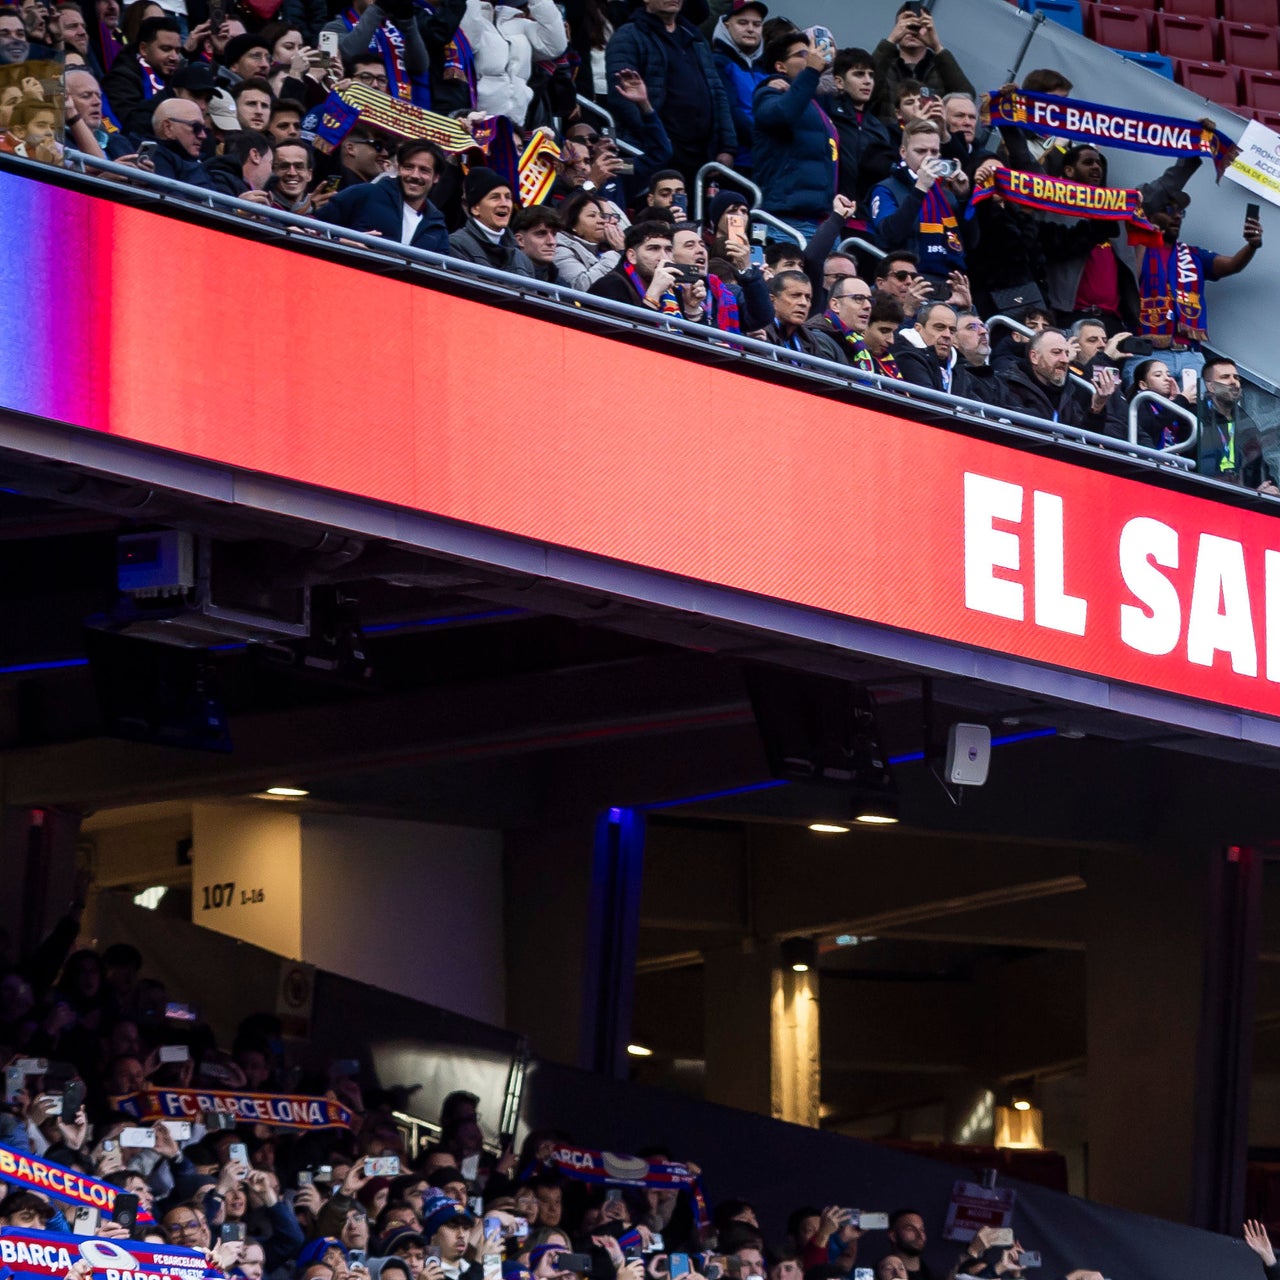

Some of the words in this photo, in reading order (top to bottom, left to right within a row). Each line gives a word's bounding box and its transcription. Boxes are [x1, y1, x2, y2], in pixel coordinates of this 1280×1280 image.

[1033, 101, 1060, 127] FC
[1065, 107, 1193, 150] BARCELONA
[1010, 170, 1032, 195] FC
[1032, 178, 1128, 211] BARCELONA
[962, 470, 1088, 638] EL
[201, 882, 235, 911] 107
[166, 1094, 196, 1115] FC
[197, 1097, 324, 1123] BARCELONA
[552, 1148, 594, 1169] ARÇA
[0, 1240, 71, 1272] BARÇA
[164, 1255, 208, 1269] BARCELONA
